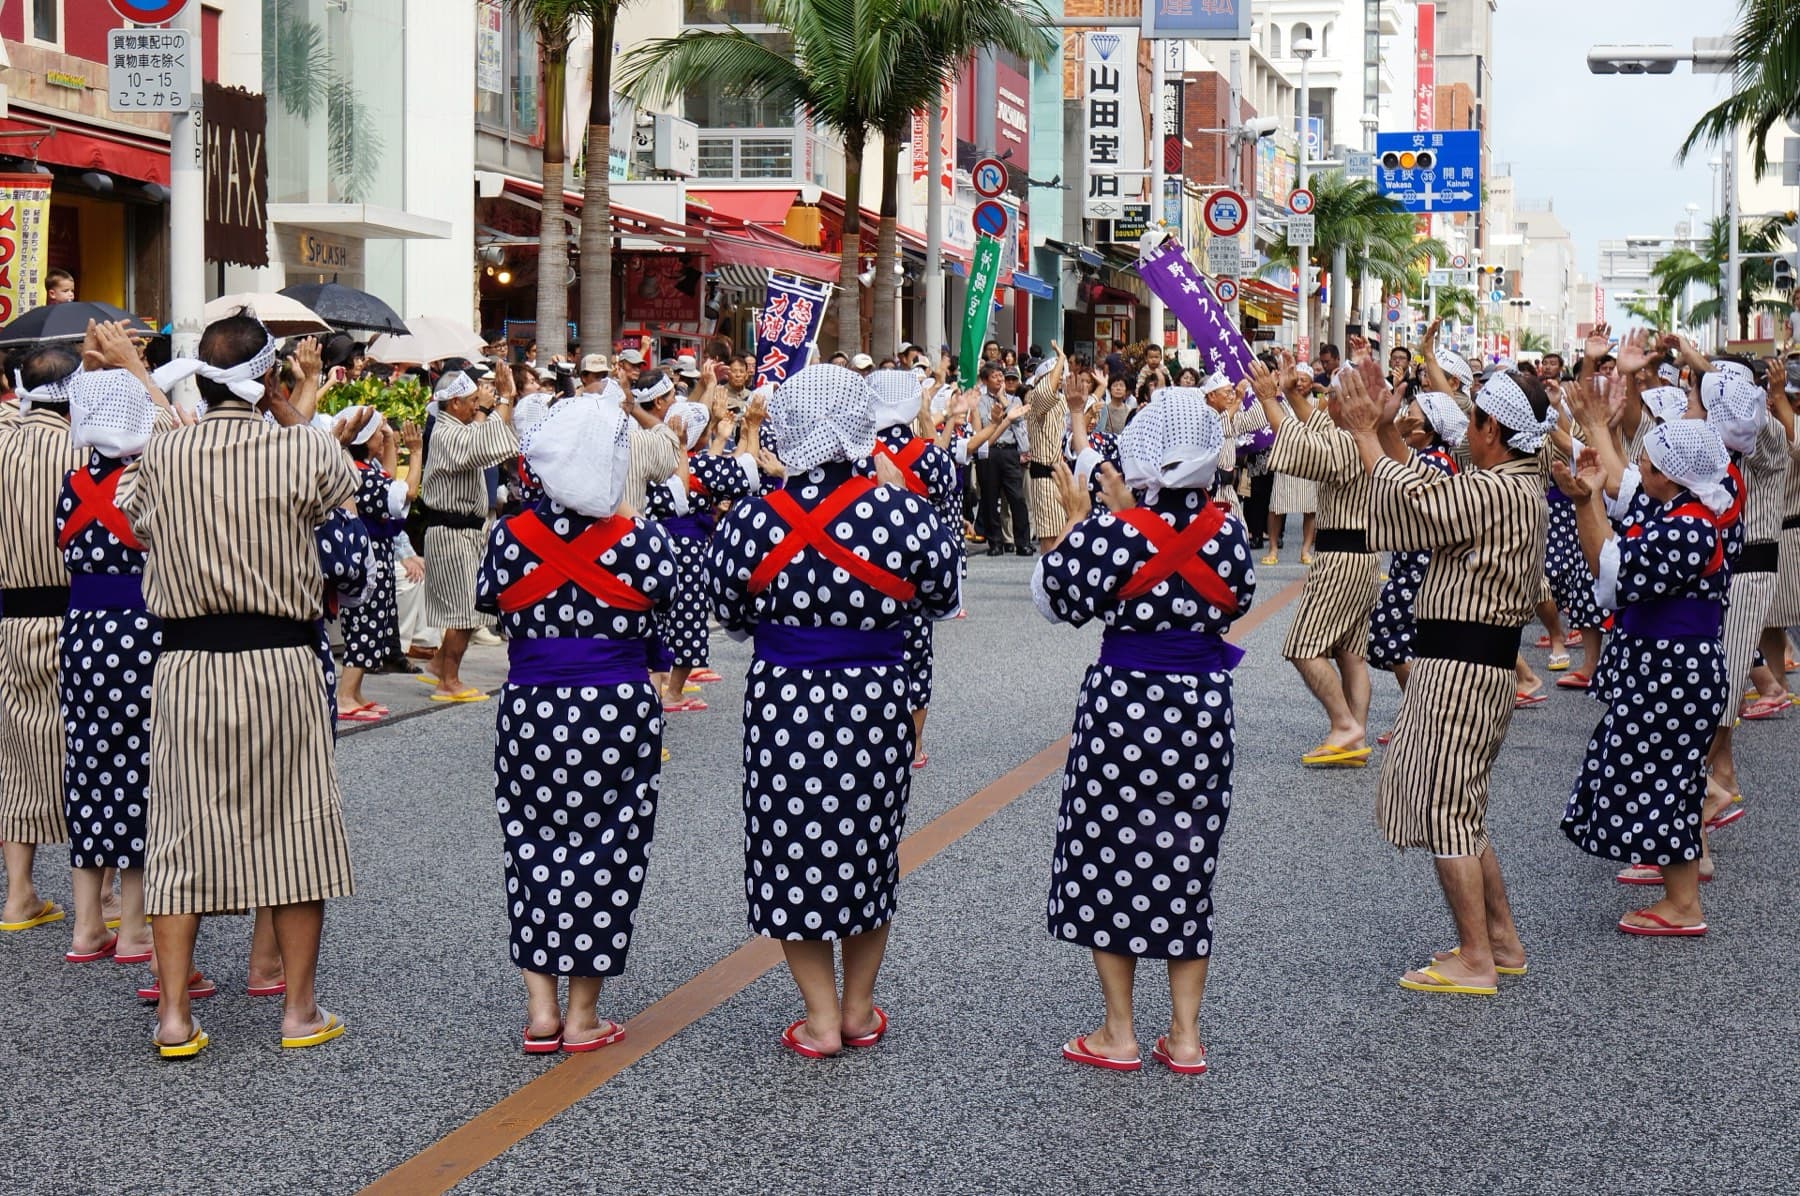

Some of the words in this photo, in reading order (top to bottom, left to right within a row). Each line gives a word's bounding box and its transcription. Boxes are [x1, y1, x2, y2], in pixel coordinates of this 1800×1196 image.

[113, 35, 185, 50] 貨物集配中の
[113, 53, 185, 69] 貨物車を除く
[119, 91, 182, 106] ここから
[1088, 64, 1120, 198] 山田宝石
[1412, 133, 1444, 147] 安里
[205, 121, 263, 230] MAX
[1443, 167, 1474, 180] 開南
[1385, 181, 1412, 189] Wakasa
[1446, 180, 1470, 188] Kainan
[308, 236, 346, 266] SPLASH
